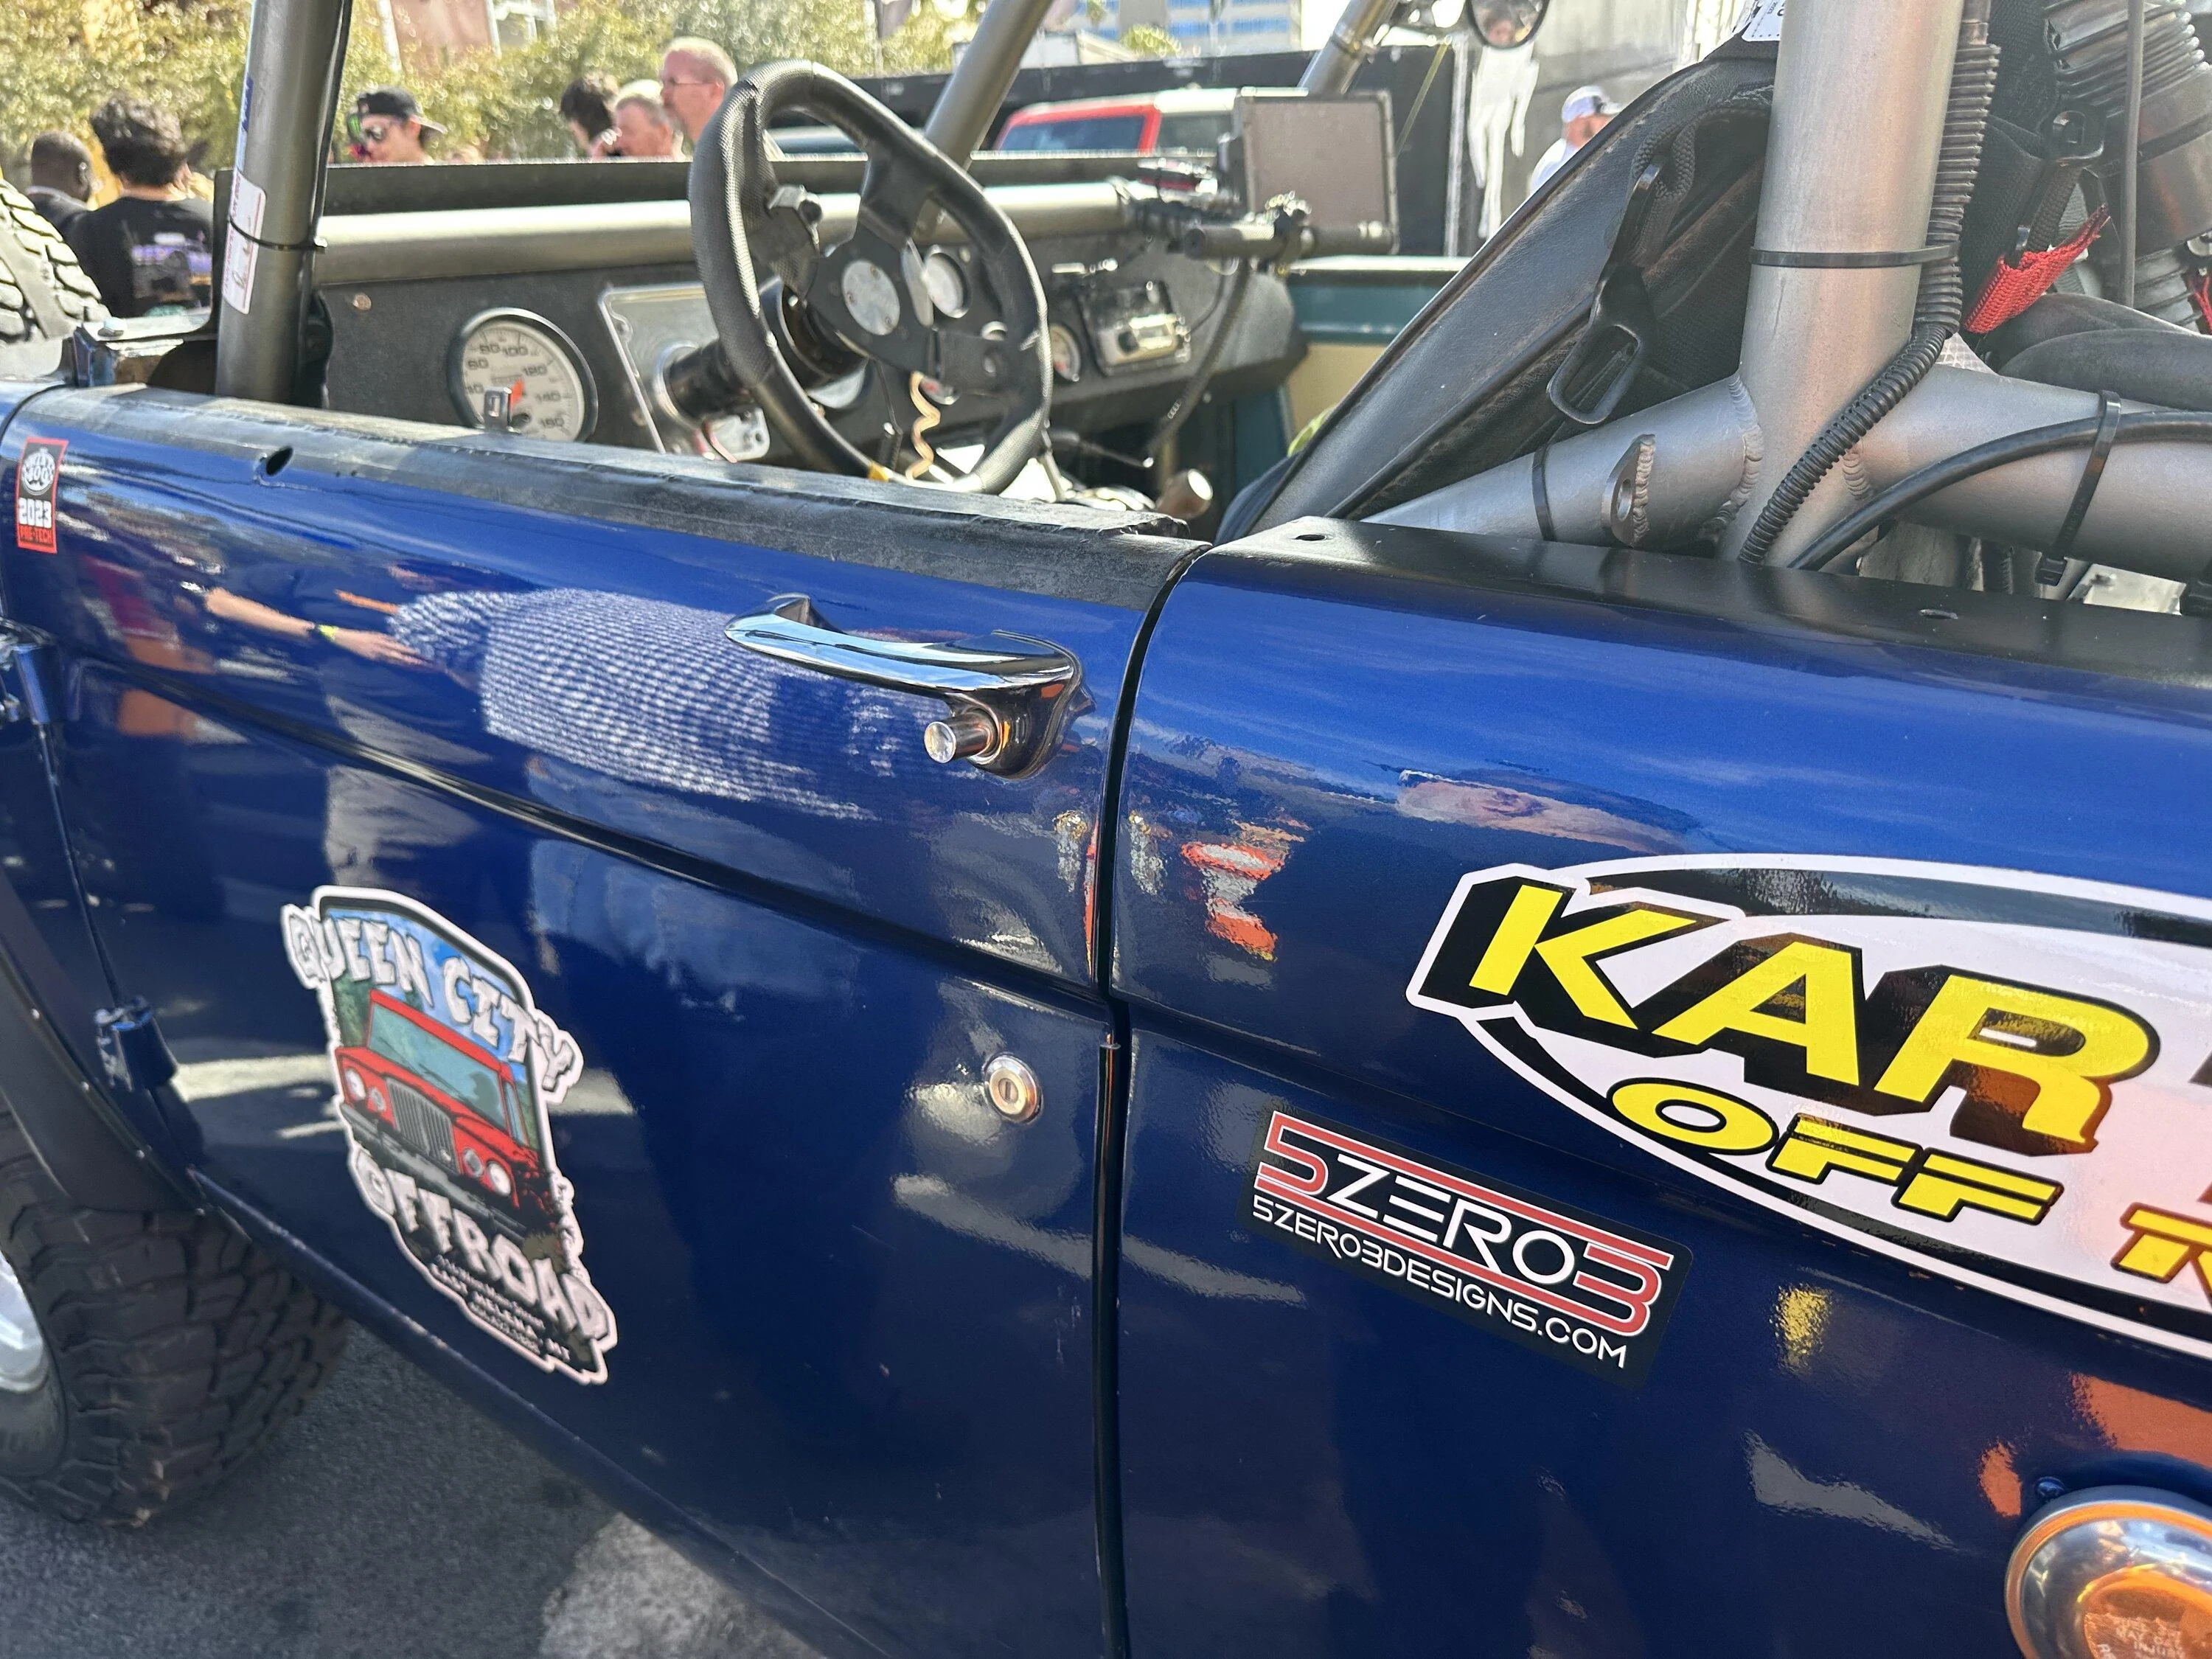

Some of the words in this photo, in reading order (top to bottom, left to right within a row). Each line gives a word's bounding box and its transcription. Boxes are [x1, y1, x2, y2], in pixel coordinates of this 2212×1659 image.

[18, 497, 52, 529] 2023
[286, 908, 436, 1009] QUEEN
[442, 956, 574, 1092] CITY
[1419, 876, 2212, 1156] KAR
[1608, 1077, 2065, 1224] OFF
[1253, 1194, 1627, 1369] 5ZERO3DESIGNS.COM
